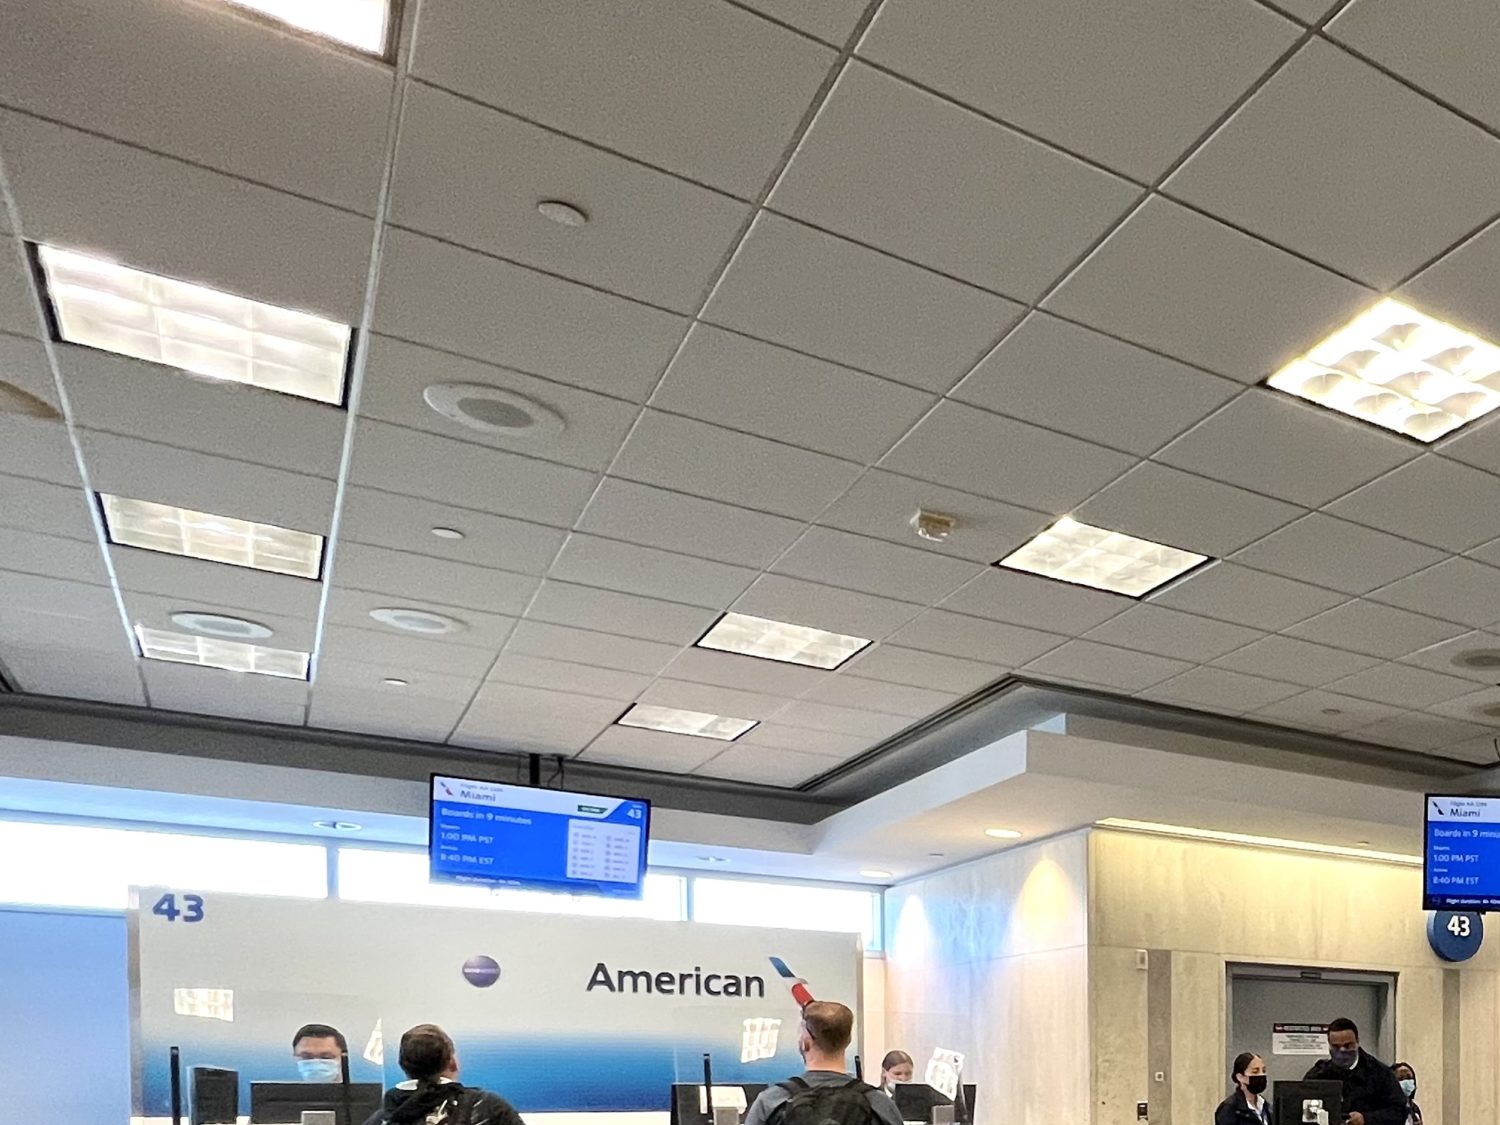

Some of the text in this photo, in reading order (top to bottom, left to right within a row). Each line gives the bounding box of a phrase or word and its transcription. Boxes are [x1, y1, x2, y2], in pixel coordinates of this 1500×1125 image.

[460, 790, 497, 801] Miami
[441, 807, 474, 818] Boards
[486, 812, 494, 821] 9
[627, 808, 642, 819] 43
[1449, 808, 1480, 817] Miami
[1434, 828, 1461, 838] Boards
[1462, 830, 1471, 838] in
[1472, 829, 1479, 838] 9
[152, 894, 204, 923] 43
[1447, 915, 1471, 937] 43
[586, 962, 765, 998] American
